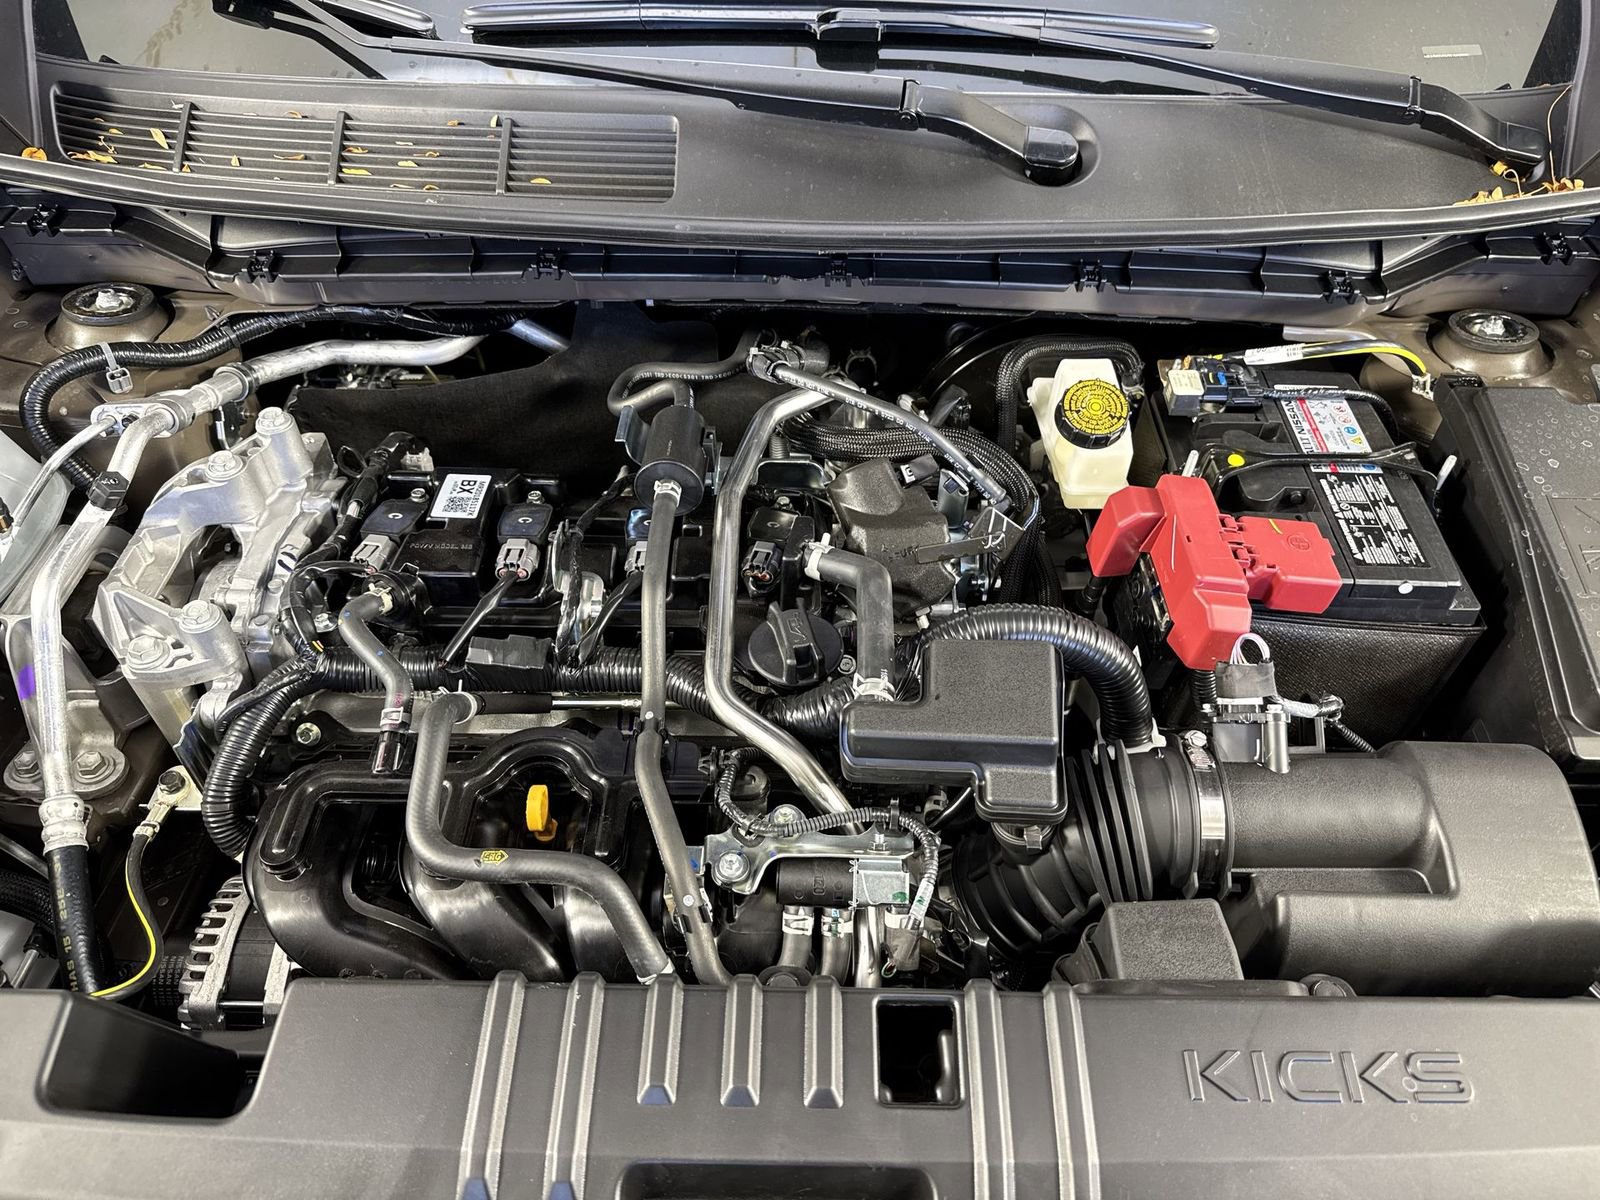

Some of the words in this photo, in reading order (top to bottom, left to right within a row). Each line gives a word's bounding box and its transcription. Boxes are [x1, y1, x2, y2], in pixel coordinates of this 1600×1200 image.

[1283, 400, 1306, 435] NISSAN
[457, 480, 478, 495] BX
[1183, 1048, 1476, 1104] KICKS
